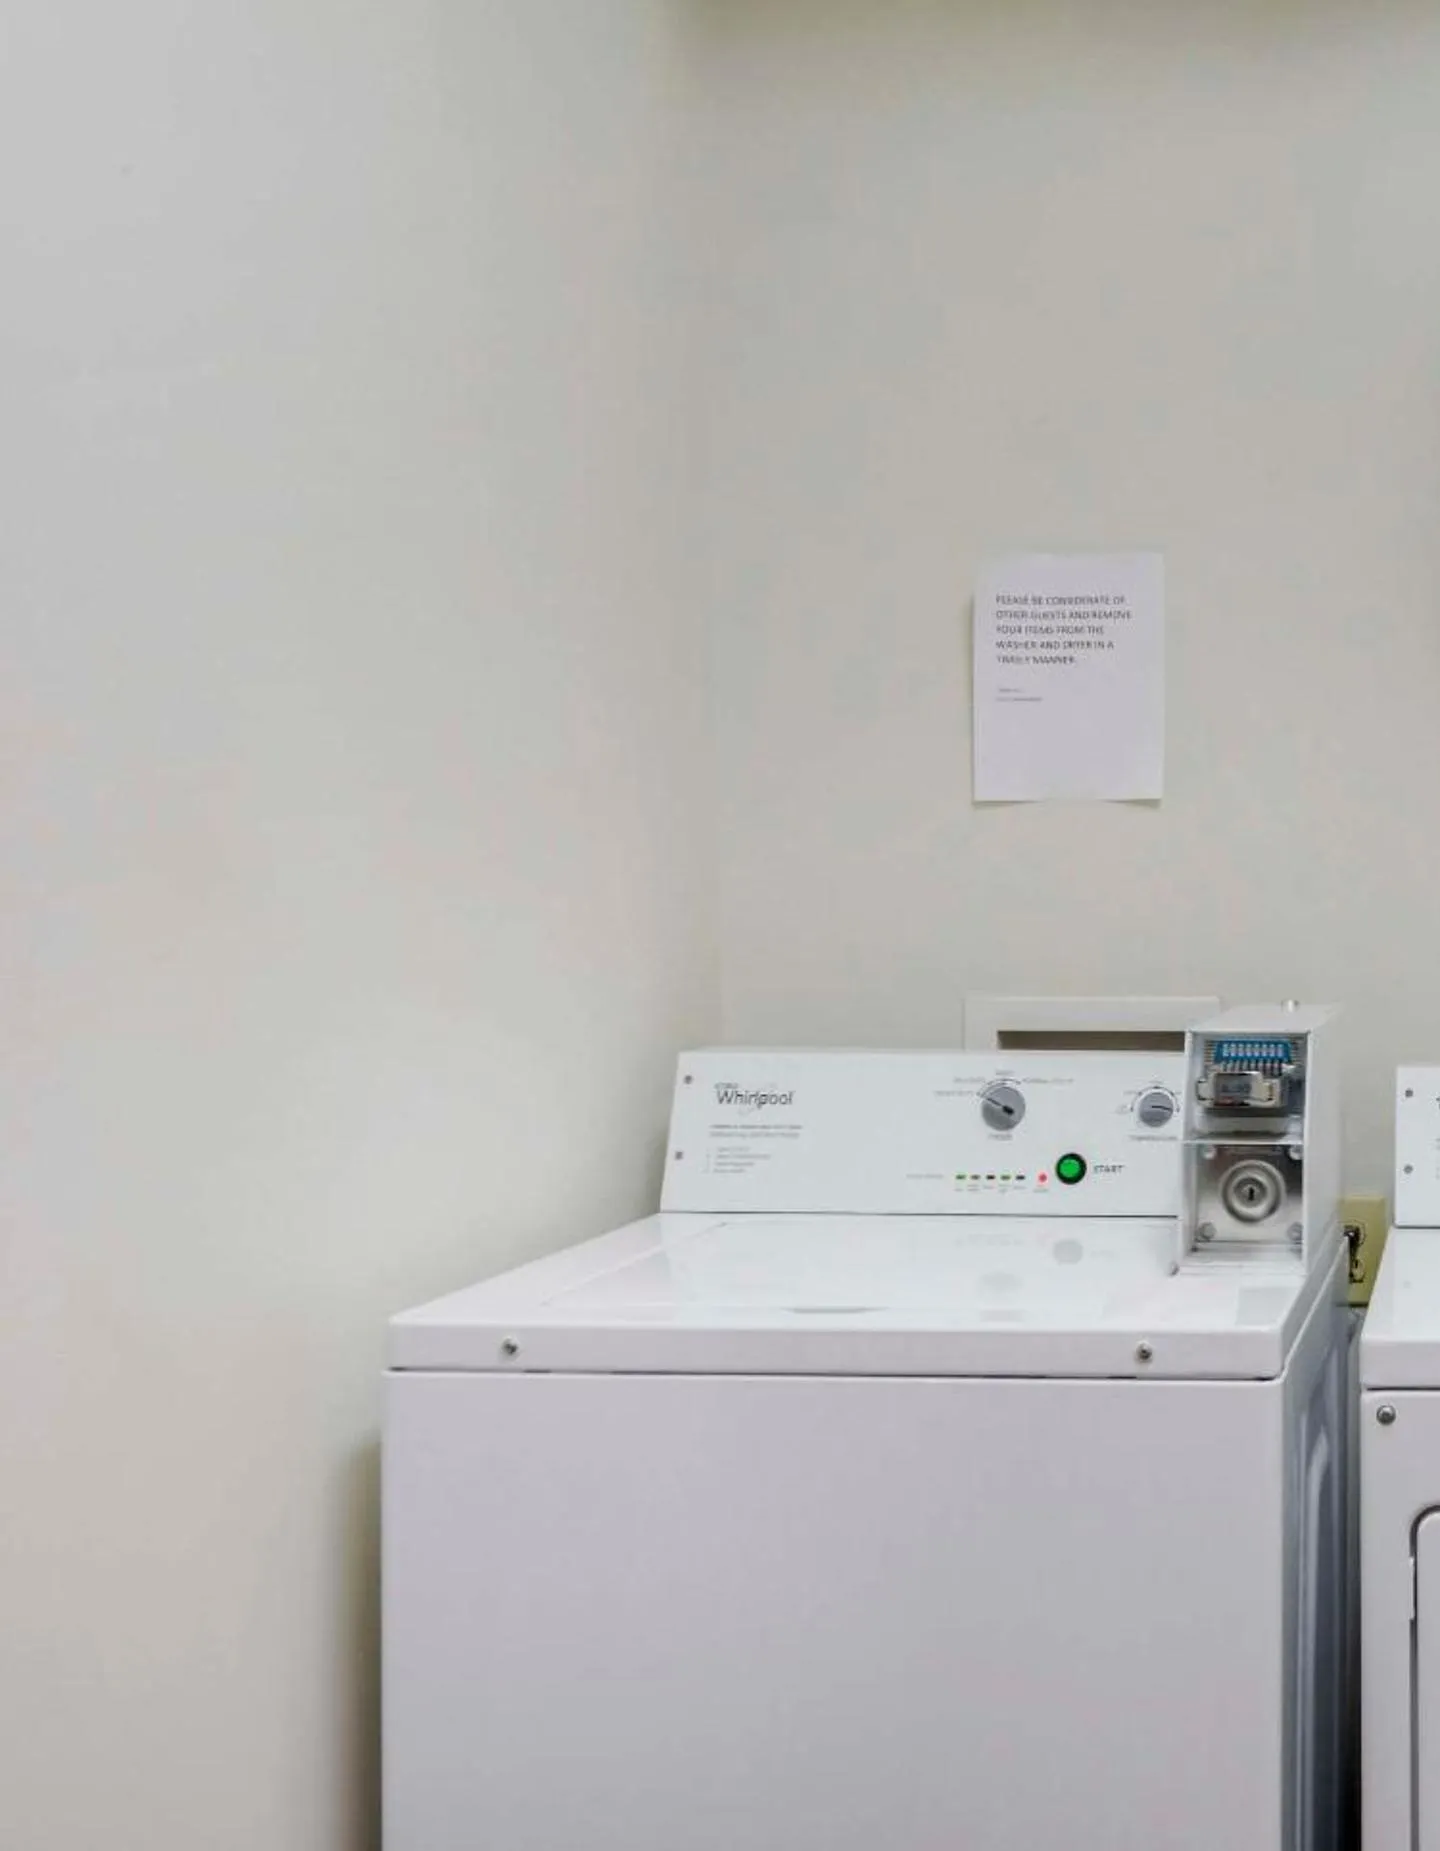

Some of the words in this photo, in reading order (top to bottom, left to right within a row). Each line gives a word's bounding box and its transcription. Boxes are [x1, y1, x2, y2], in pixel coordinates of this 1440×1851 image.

[1069, 610, 1089, 619] AND
[1088, 625, 1104, 634] THE
[995, 640, 1036, 649] WASHER
[1040, 640, 1060, 649] AND
[716, 1090, 796, 1110] Whirlpool
[1094, 1164, 1125, 1173] START
